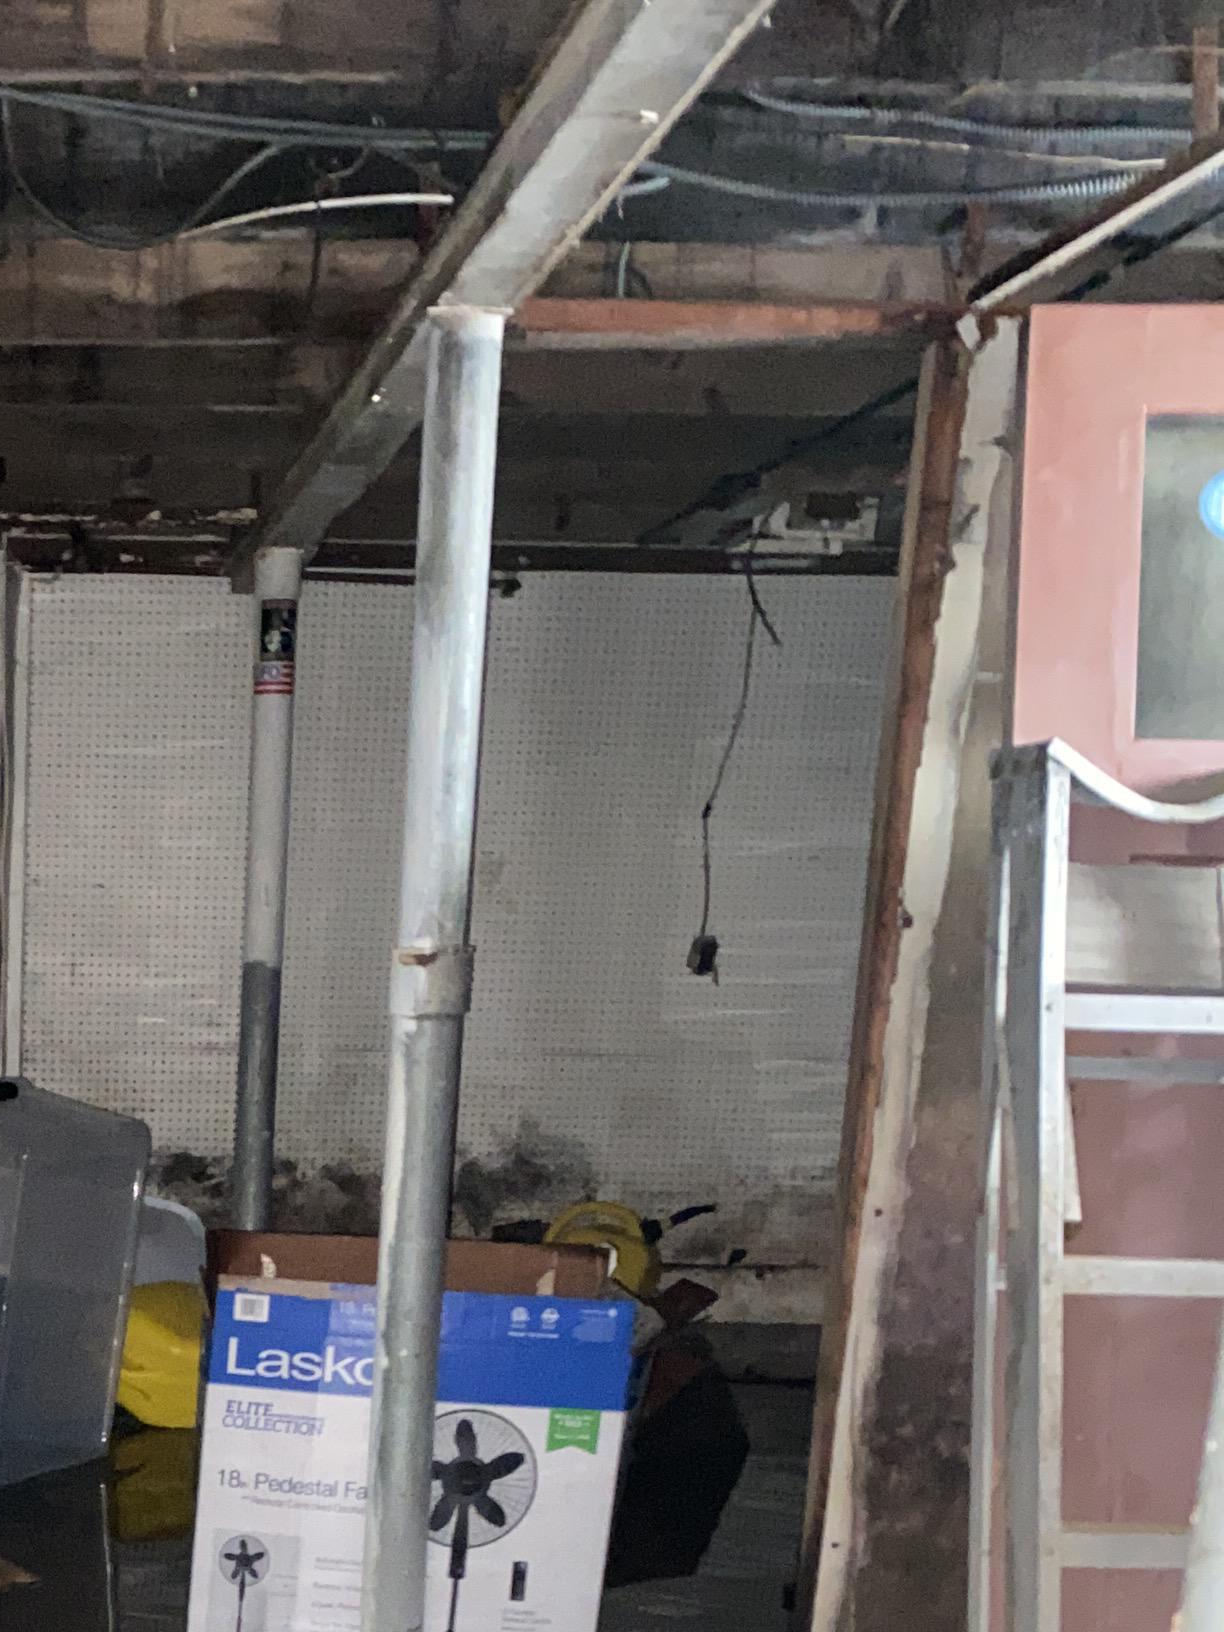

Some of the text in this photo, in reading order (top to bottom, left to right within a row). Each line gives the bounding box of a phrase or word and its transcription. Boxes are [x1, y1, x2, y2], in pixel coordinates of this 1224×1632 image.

[225, 1399, 274, 1416] ELITE
[222, 1414, 324, 1436] COLLECTION
[254, 1472, 338, 1498] Pedestal
[343, 1480, 368, 1500] Fa
